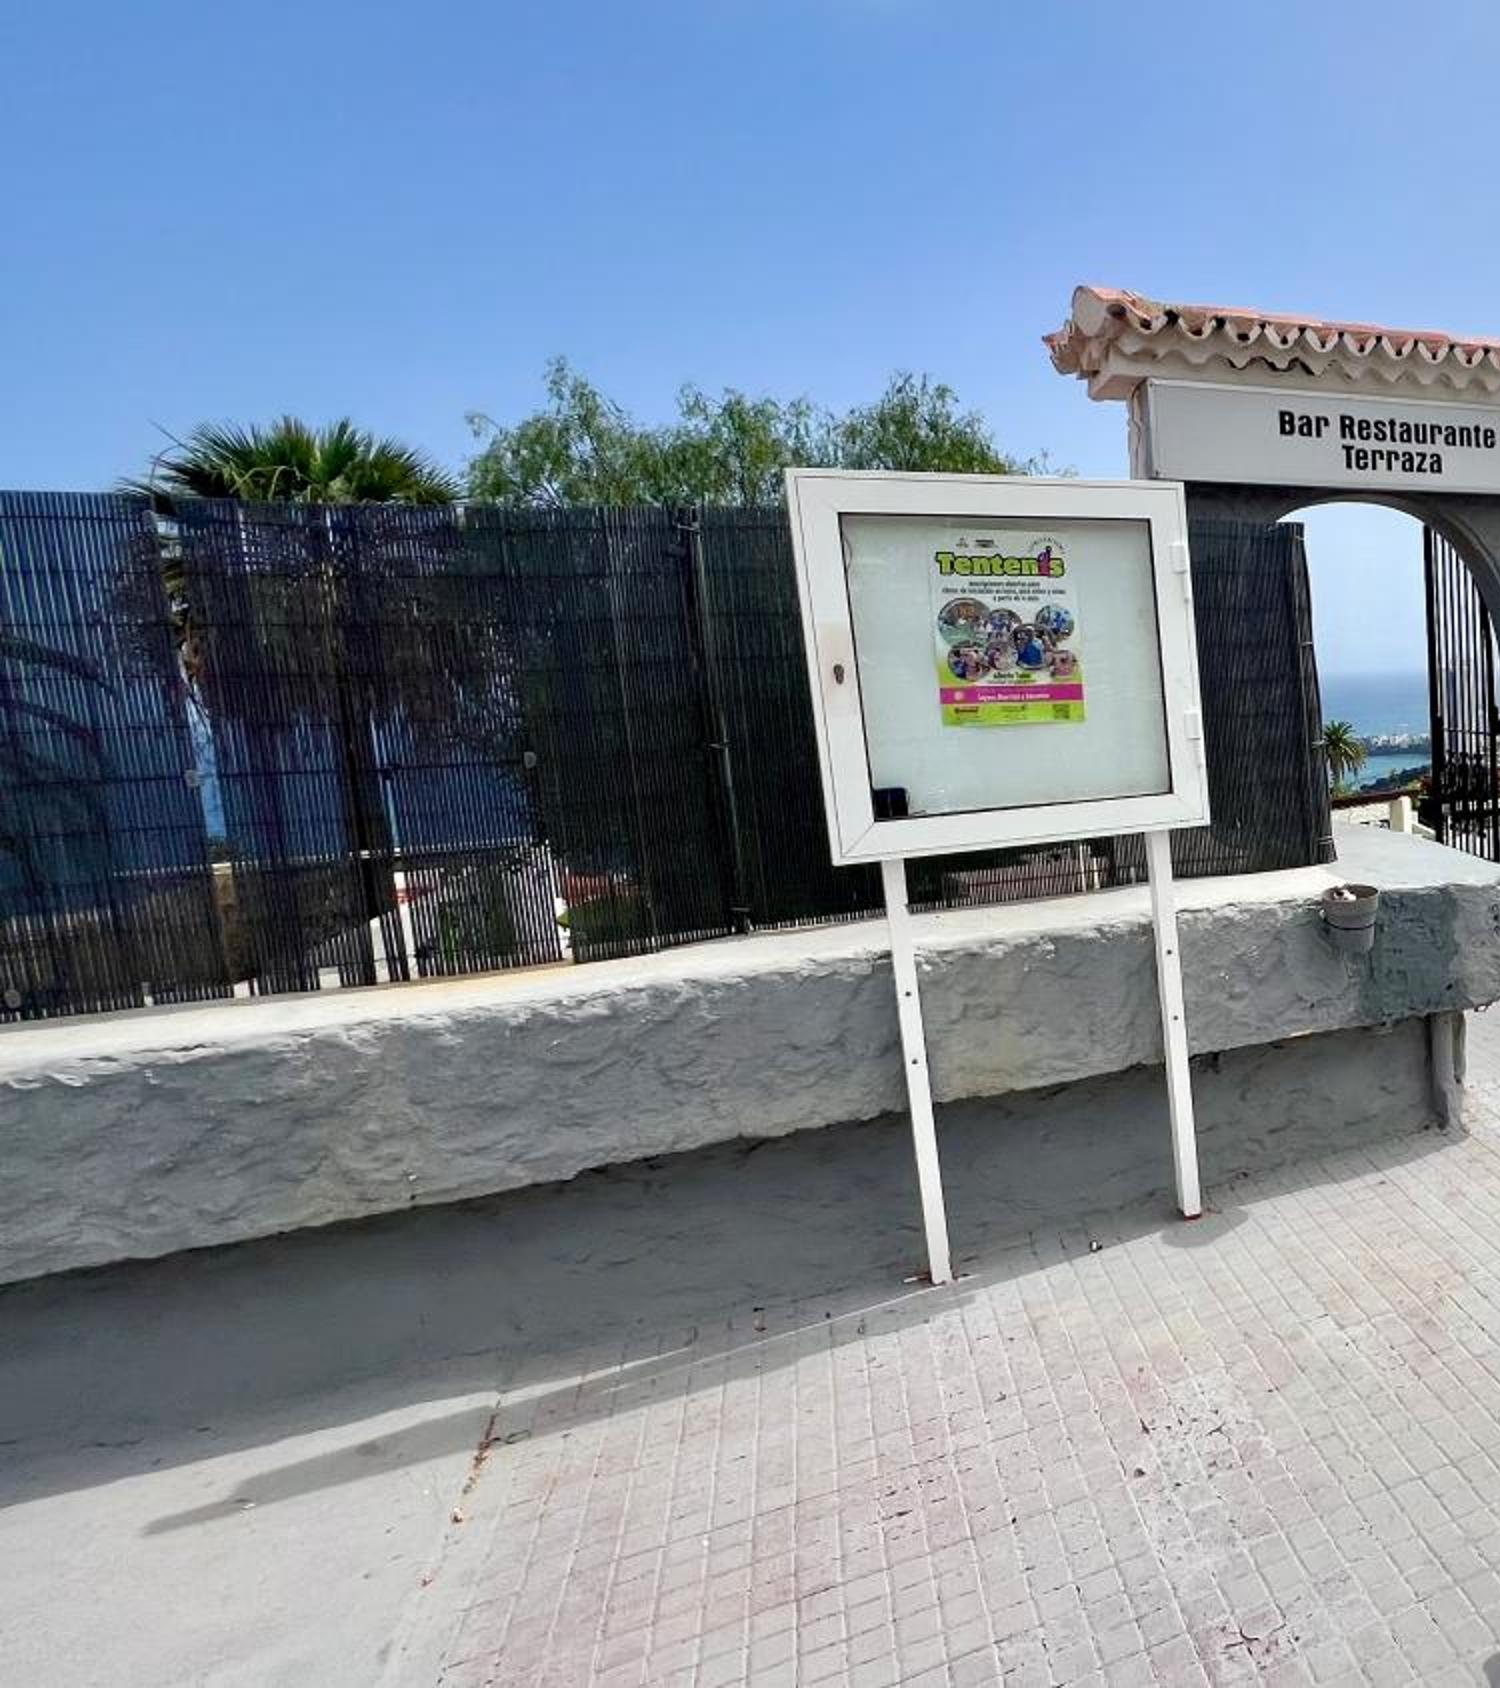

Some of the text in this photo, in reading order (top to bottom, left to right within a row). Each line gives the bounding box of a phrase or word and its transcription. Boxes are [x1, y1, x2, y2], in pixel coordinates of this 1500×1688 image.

[1278, 409, 1497, 450] Bar Restaurante
[1341, 443, 1443, 475] Terraza
[936, 549, 1065, 577] Tentenis
